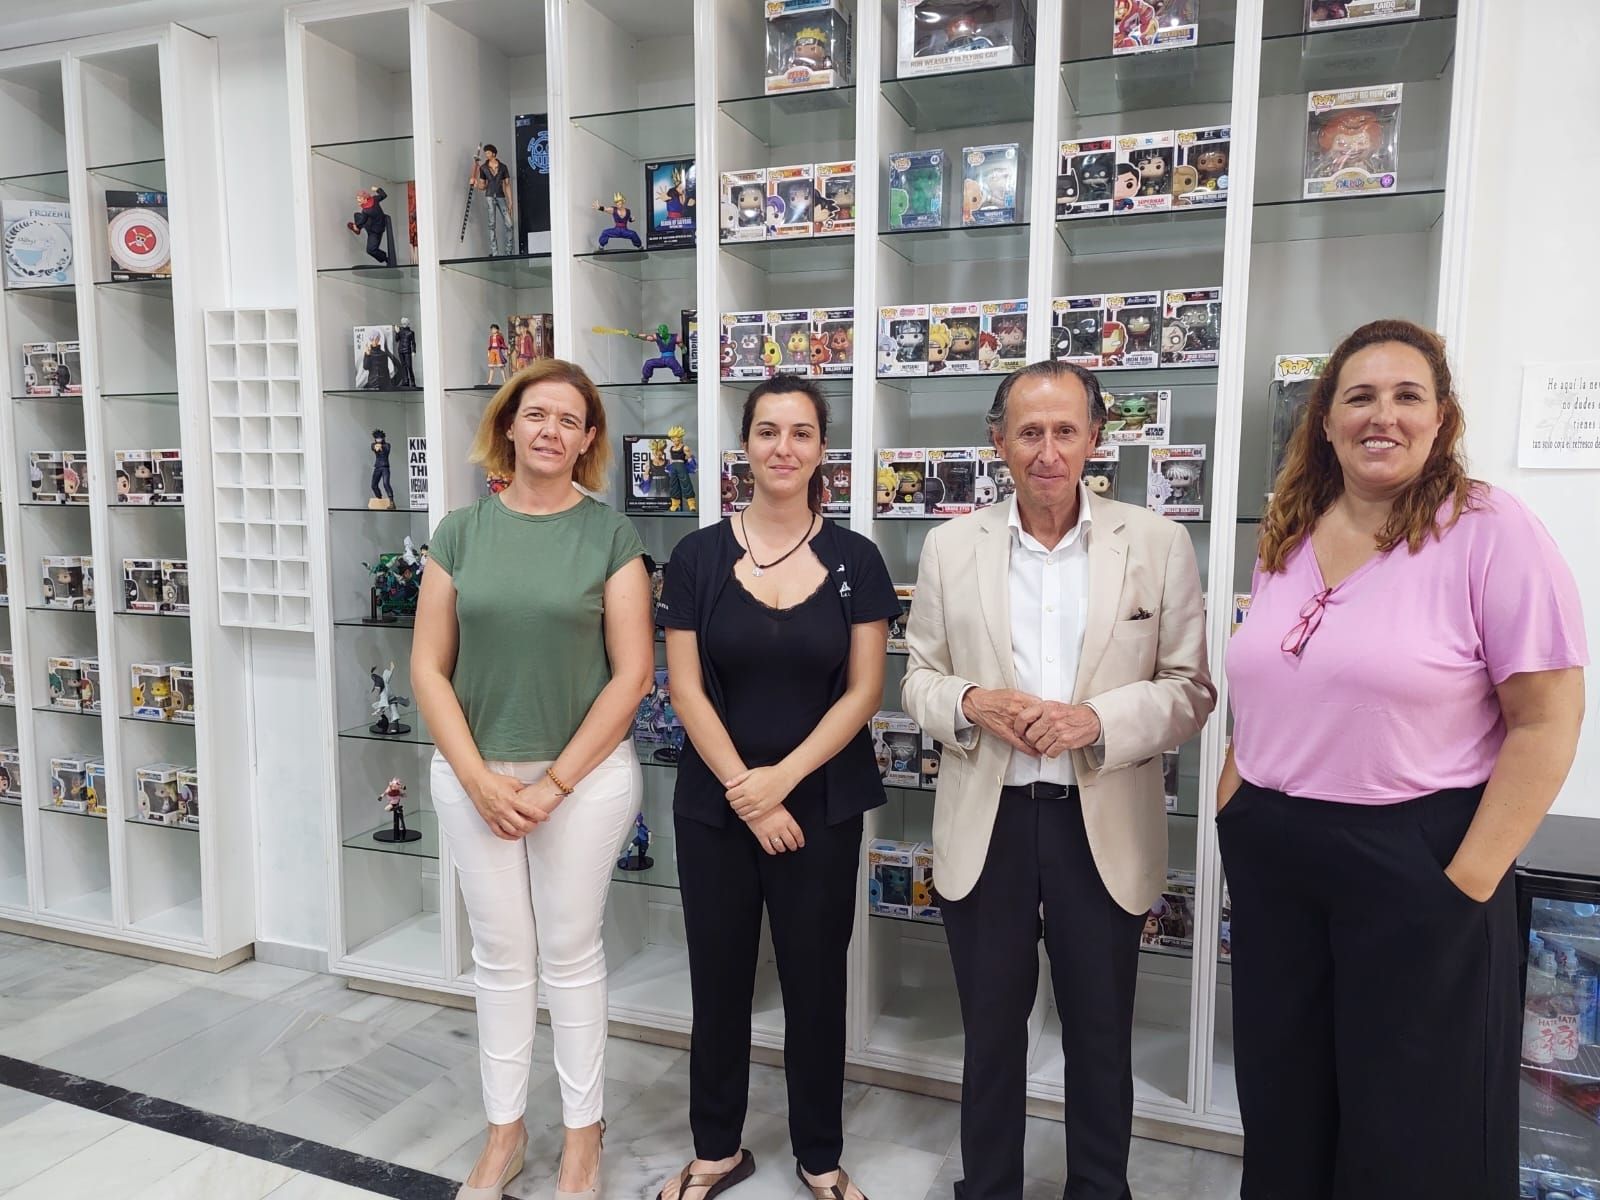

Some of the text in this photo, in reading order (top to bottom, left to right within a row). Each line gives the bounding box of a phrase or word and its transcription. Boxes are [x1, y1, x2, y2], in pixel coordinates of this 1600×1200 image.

[1374, 2, 1396, 10] KAIDO
[29, 208, 63, 218] FROZEN
[1279, 360, 1313, 377] POP!
[1547, 377, 1557, 390] He
[1560, 378, 1576, 394] aquí
[1579, 377, 1586, 390] la
[1562, 396, 1595, 410] no dudes
[1573, 421, 1595, 430] tienes
[1532, 440, 1541, 449] tan
[1542, 438, 1552, 449] solo
[1572, 437, 1594, 449] refresco
[410, 451, 426, 464] AR
